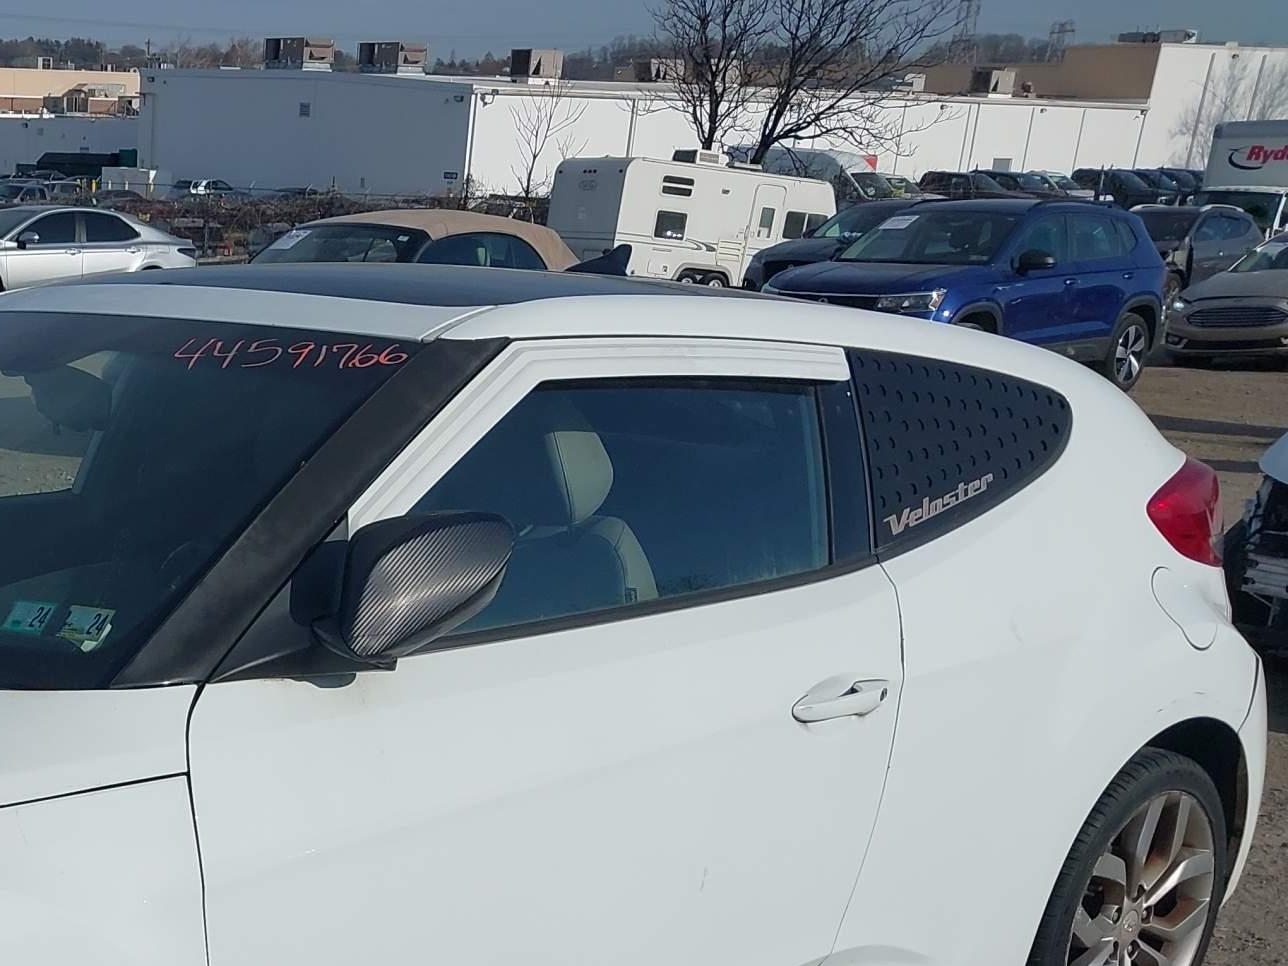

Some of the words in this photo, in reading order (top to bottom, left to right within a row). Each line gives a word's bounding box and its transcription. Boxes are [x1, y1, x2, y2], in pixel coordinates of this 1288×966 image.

[174, 338, 409, 370] 44591766
[883, 473, 994, 536] Veloster
[28, 606, 52, 628] 24
[85, 613, 109, 636] 24
